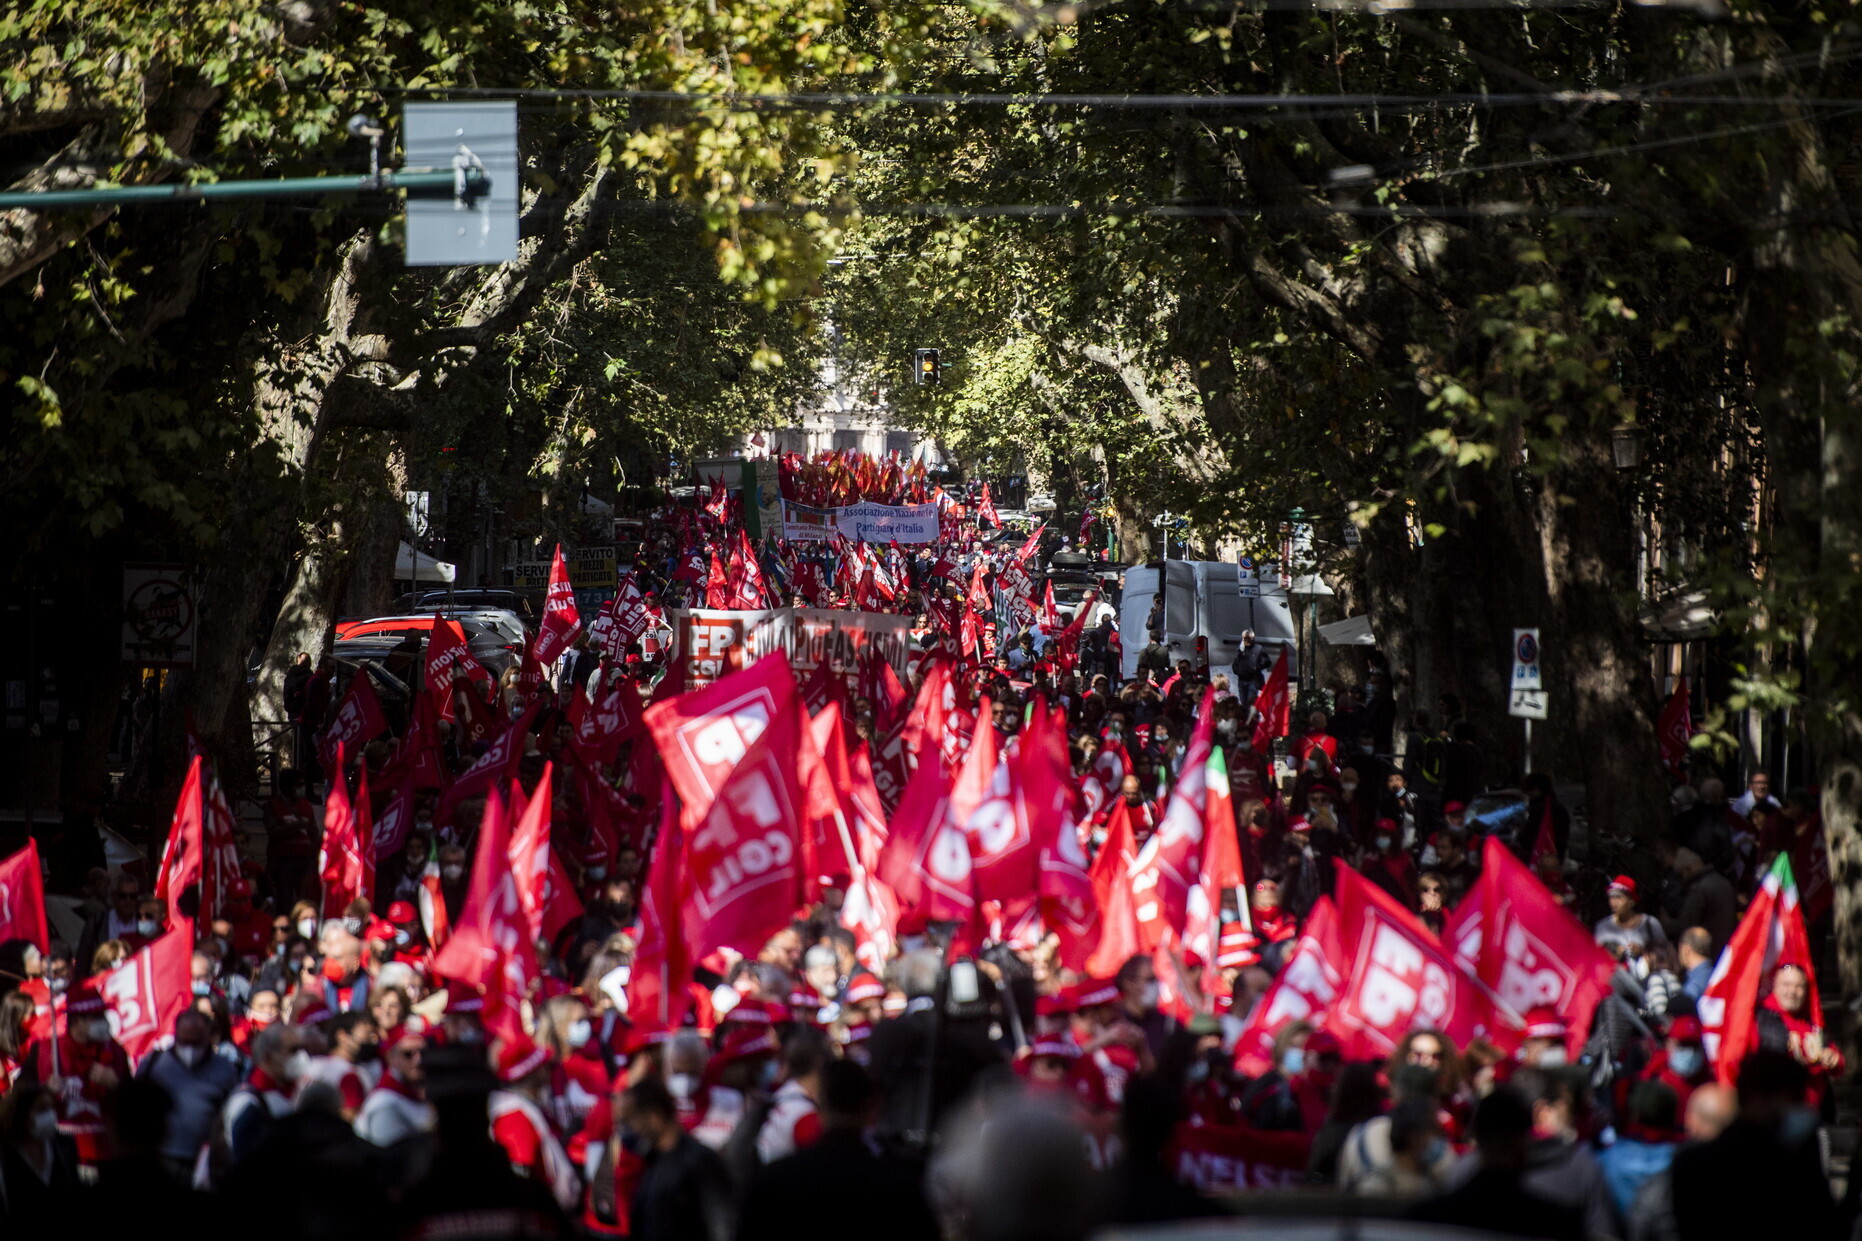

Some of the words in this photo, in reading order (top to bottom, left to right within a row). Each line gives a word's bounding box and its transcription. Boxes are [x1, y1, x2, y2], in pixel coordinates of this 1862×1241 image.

[843, 507, 895, 518] Associazione
[895, 523, 924, 533] d'Italia
[516, 566, 550, 577] SERVI
[687, 625, 736, 656] FP
[688, 659, 722, 677] CGI
